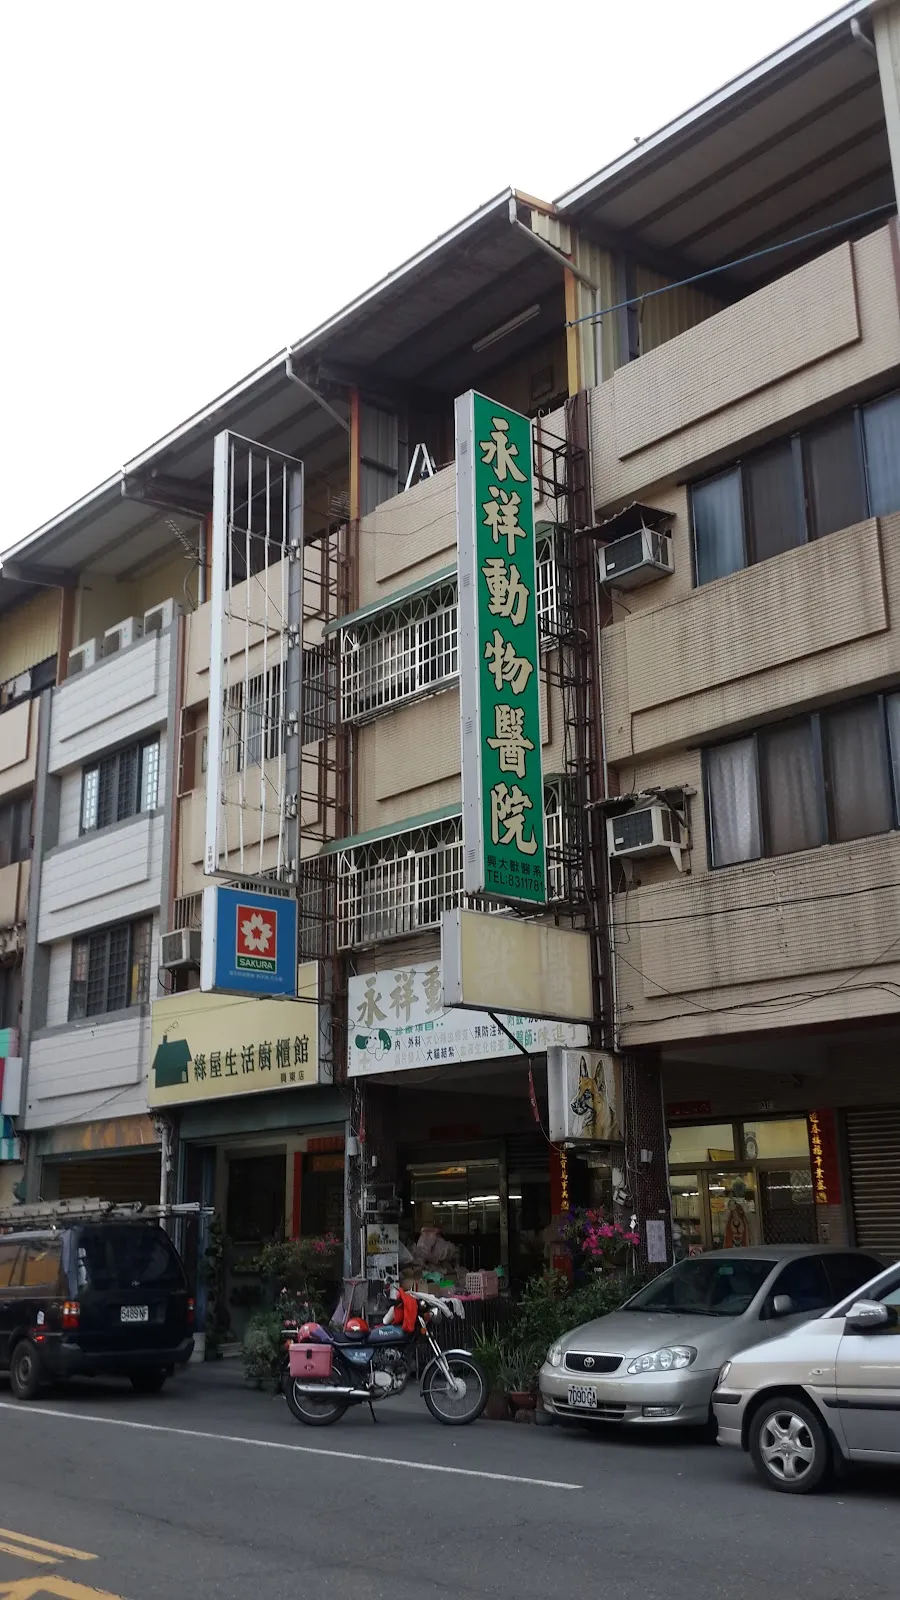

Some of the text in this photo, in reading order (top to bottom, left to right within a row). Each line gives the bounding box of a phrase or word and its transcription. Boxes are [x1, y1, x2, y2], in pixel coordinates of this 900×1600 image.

[479, 416, 538, 856] 永祥動物醫院
[239, 958, 273, 970] SAKURA
